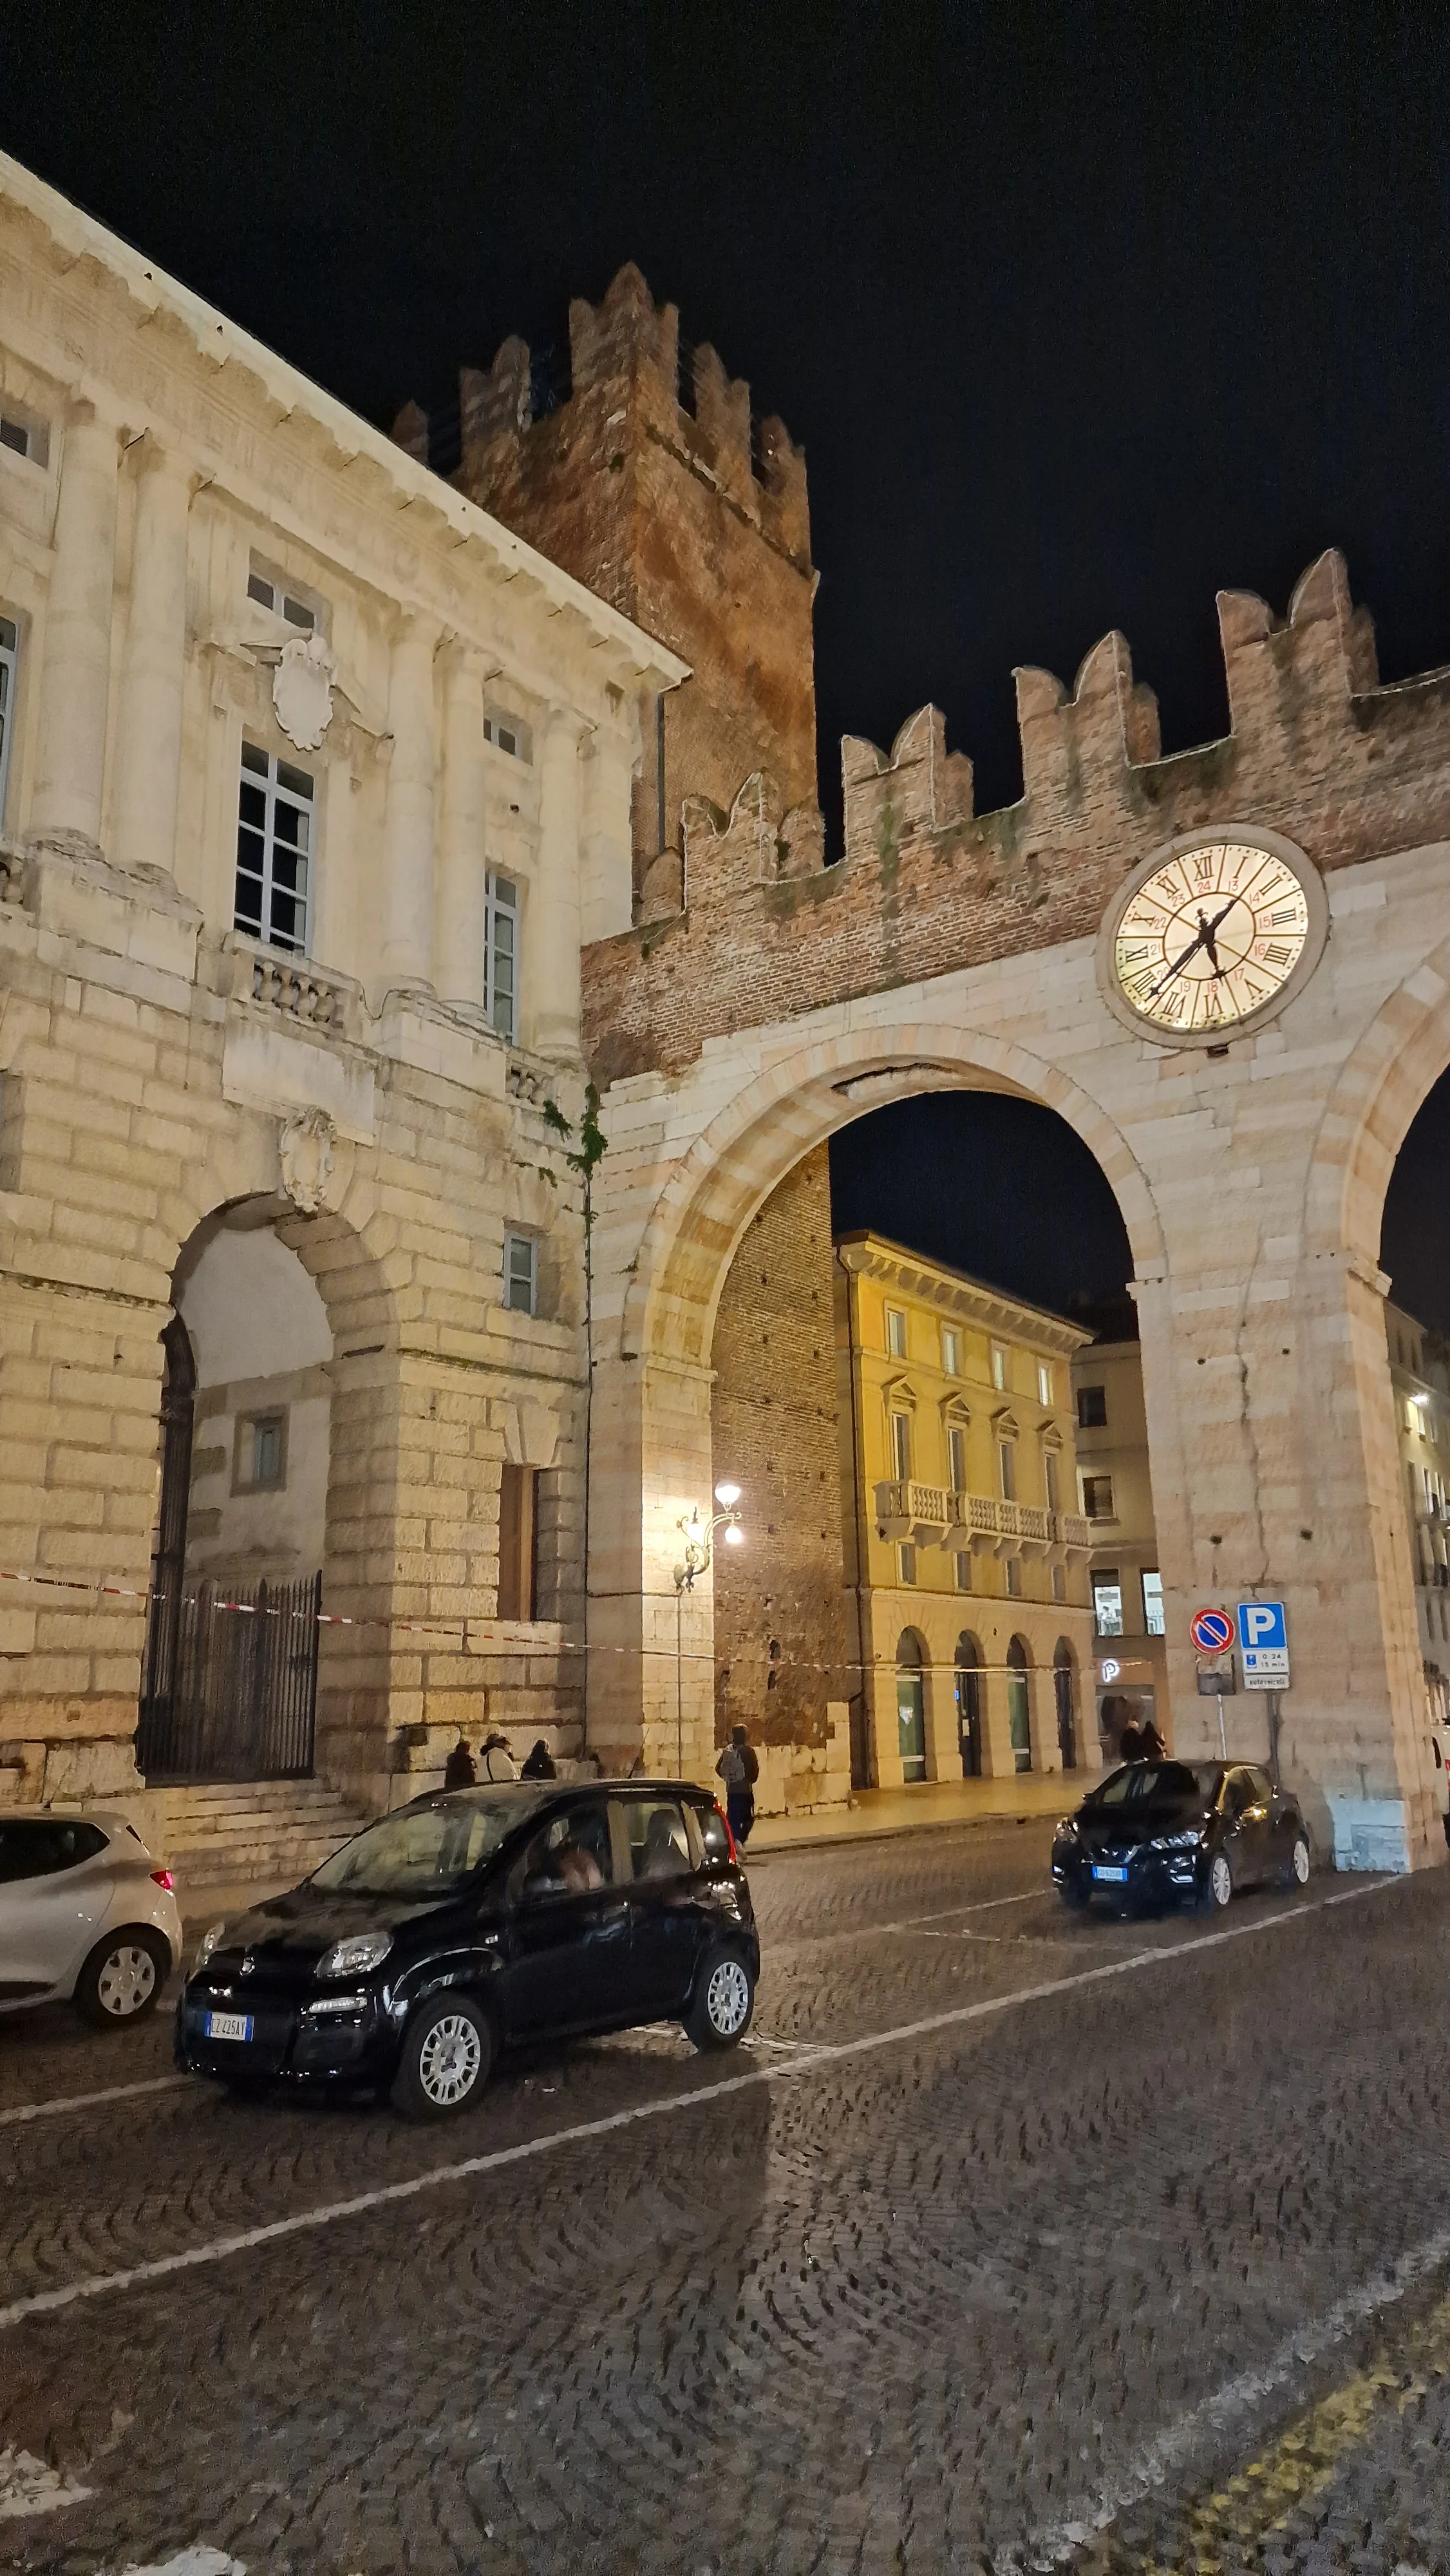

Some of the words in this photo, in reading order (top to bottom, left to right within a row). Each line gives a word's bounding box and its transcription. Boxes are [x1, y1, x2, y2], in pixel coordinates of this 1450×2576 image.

[1192, 855, 1214, 881] XII
[1232, 856, 1248, 878] I
[1156, 875, 1180, 899] XI
[1198, 880, 1211, 893] 24
[1228, 880, 1238, 893] 13
[1259, 873, 1284, 896] II
[1172, 894, 1185, 907] 23
[1249, 891, 1260, 904] 14
[1131, 911, 1156, 926] X
[1153, 917, 1167, 929] 22
[1259, 916, 1271, 929] 15
[1271, 907, 1297, 927] III
[1125, 944, 1149, 963] IX
[1150, 943, 1161, 955] 21
[1254, 943, 1266, 956] 16
[1263, 942, 1293, 966] IIII
[1234, 967, 1245, 981] 17
[1180, 981, 1191, 992] 19
[1207, 981, 1218, 993] 18
[1244, 978, 1264, 999] V
[1160, 990, 1186, 1018] VII
[1203, 992, 1225, 1018] VI
[1247, 1607, 1276, 1645] P
